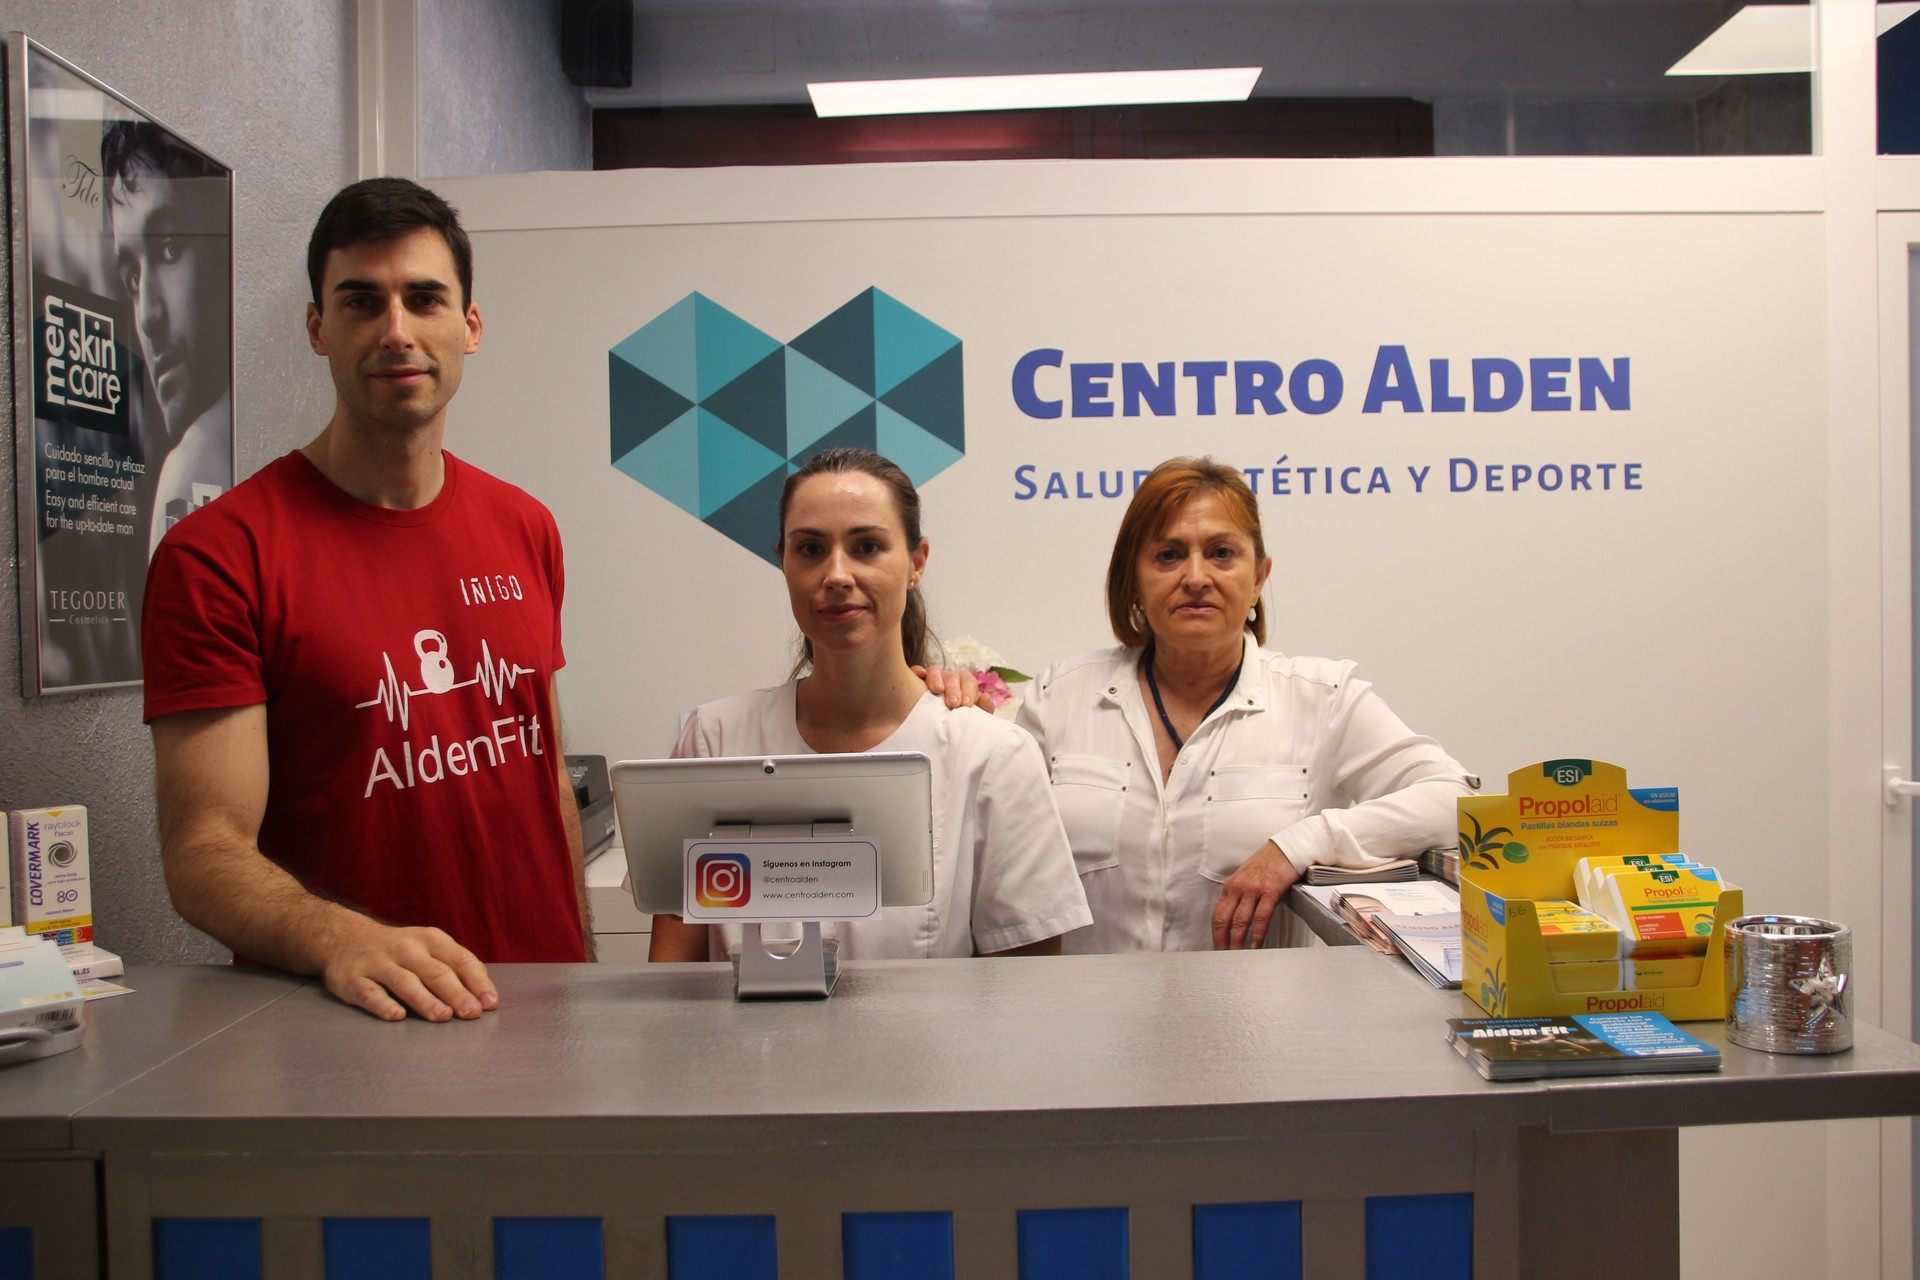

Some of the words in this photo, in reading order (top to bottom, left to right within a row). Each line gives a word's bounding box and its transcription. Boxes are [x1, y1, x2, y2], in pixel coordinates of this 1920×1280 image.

[45, 295, 65, 405] men
[69, 321, 116, 371] skin
[69, 364, 121, 404] care
[1012, 348, 1344, 419] CENTRO
[1362, 345, 1631, 413] ALDEN
[45, 442, 81, 464] Cuidado
[84, 452, 113, 469] sencillo
[115, 460, 121, 474] y
[122, 456, 145, 474] eficaz
[46, 468, 66, 483] para
[68, 466, 75, 482] el
[78, 467, 109, 487] hombre
[111, 476, 134, 491] actual
[1244, 454, 1391, 494] TÉTICA
[1408, 466, 1431, 493] Y
[1449, 458, 1642, 493] DEPORTE
[46, 490, 66, 511] Easy
[68, 494, 84, 509] and
[86, 495, 118, 513] efficient
[119, 504, 136, 515] care
[46, 511, 58, 528] for
[60, 513, 73, 530] the
[75, 517, 115, 535] up-to-date
[117, 524, 134, 535] man
[50, 590, 126, 610] TEGODER
[460, 575, 523, 605] IÑIGO
[69, 614, 109, 625] Cosmetics
[364, 714, 543, 798] AldenFit
[1556, 769, 1579, 784] ESI
[1519, 795, 1618, 818] Propolaid
[44, 820, 82, 831] rayblock
[1521, 822, 1555, 830] Pastillas
[1557, 820, 1590, 829] blandas
[1592, 819, 1618, 827] suizas
[27, 820, 43, 906] COVERMARK
[812, 860, 851, 868] Instagram
[763, 876, 819, 884] @centroalden
[1660, 874, 1674, 882] ESI
[763, 891, 854, 899] www.centroalden.com
[1643, 886, 1699, 898] Propolaid
[1586, 994, 1665, 1012] Propolaid
[1472, 1028, 1538, 1038] Alden
[1540, 1026, 1569, 1035] Fit
